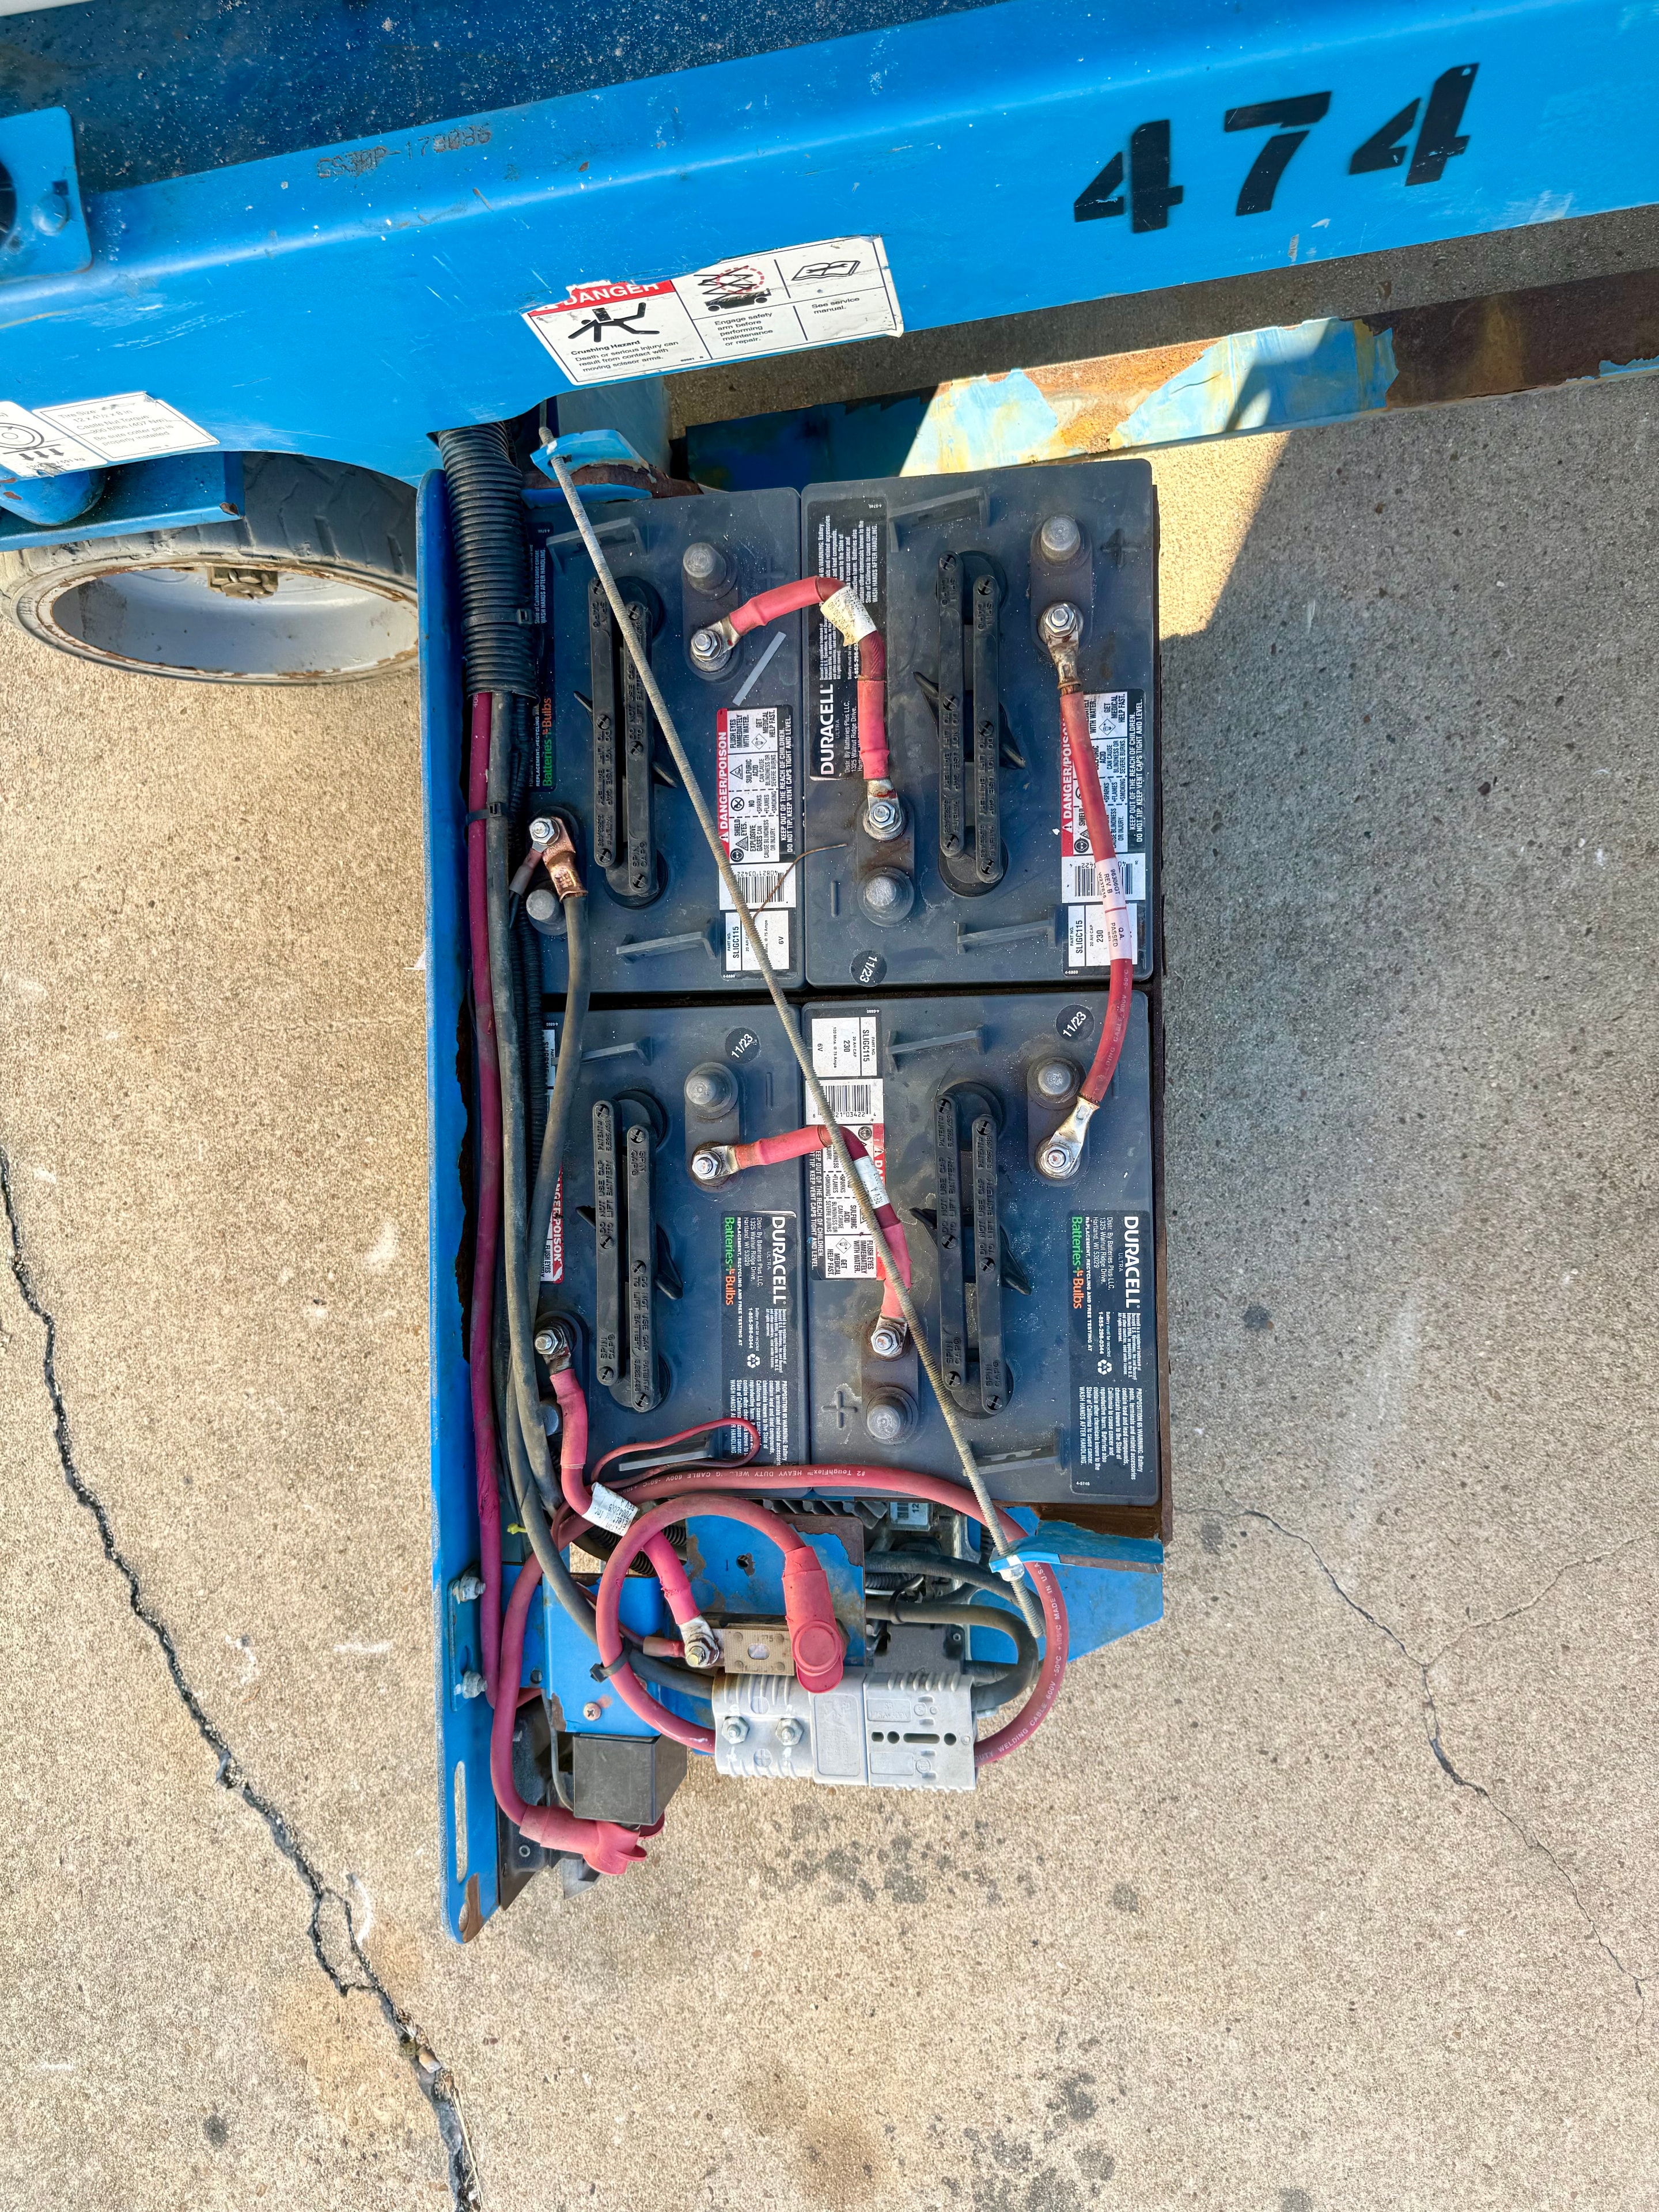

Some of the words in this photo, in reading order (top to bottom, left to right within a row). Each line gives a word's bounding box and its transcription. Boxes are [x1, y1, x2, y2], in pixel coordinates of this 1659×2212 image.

[830, 297, 860, 306] service
[813, 306, 846, 315] manual.
[714, 316, 746, 327] Engage
[748, 312, 772, 321] safety
[735, 320, 762, 328] before
[719, 325, 763, 338] performing
[722, 329, 774, 342] maintenance
[571, 344, 610, 356] Crushing
[611, 340, 641, 349] Hazard
[736, 337, 761, 346] repair.
[575, 352, 598, 362] Death
[610, 347, 639, 357] serious
[578, 359, 601, 368] result
[602, 355, 620, 364] from
[622, 351, 651, 360] contact
[582, 363, 611, 373] moving
[612, 359, 639, 368] scissor
[641, 355, 664, 363] arms.
[77, 423, 102, 431] Castle
[104, 419, 120, 427] Nut
[127, 428, 150, 436] cotter
[150, 425, 165, 434] pin
[101, 437, 135, 447] properly
[136, 430, 170, 440] installed
[779, 760, 785, 768] OF
[718, 732, 729, 830] DANGER/POISON
[780, 803, 786, 812] OF
[787, 844, 793, 852] DO
[778, 936, 784, 945] 6V
[1110, 922, 1118, 948] PASSED
[859, 956, 878, 983] 11/23
[1063, 1011, 1087, 1037] 11/23
[731, 1033, 753, 1058] 11/23
[817, 1043, 823, 1052] 6V
[1093, 1242, 1099, 1250] WI
[641, 1276, 647, 1288] DO
[1046, 1585, 1052, 1593] IN
[1050, 1597, 1060, 1620] MADE
[997, 1728, 1029, 1752] WELDING
[1029, 1702, 1047, 1726] CABLE
[1046, 1680, 1056, 1700] 600V
